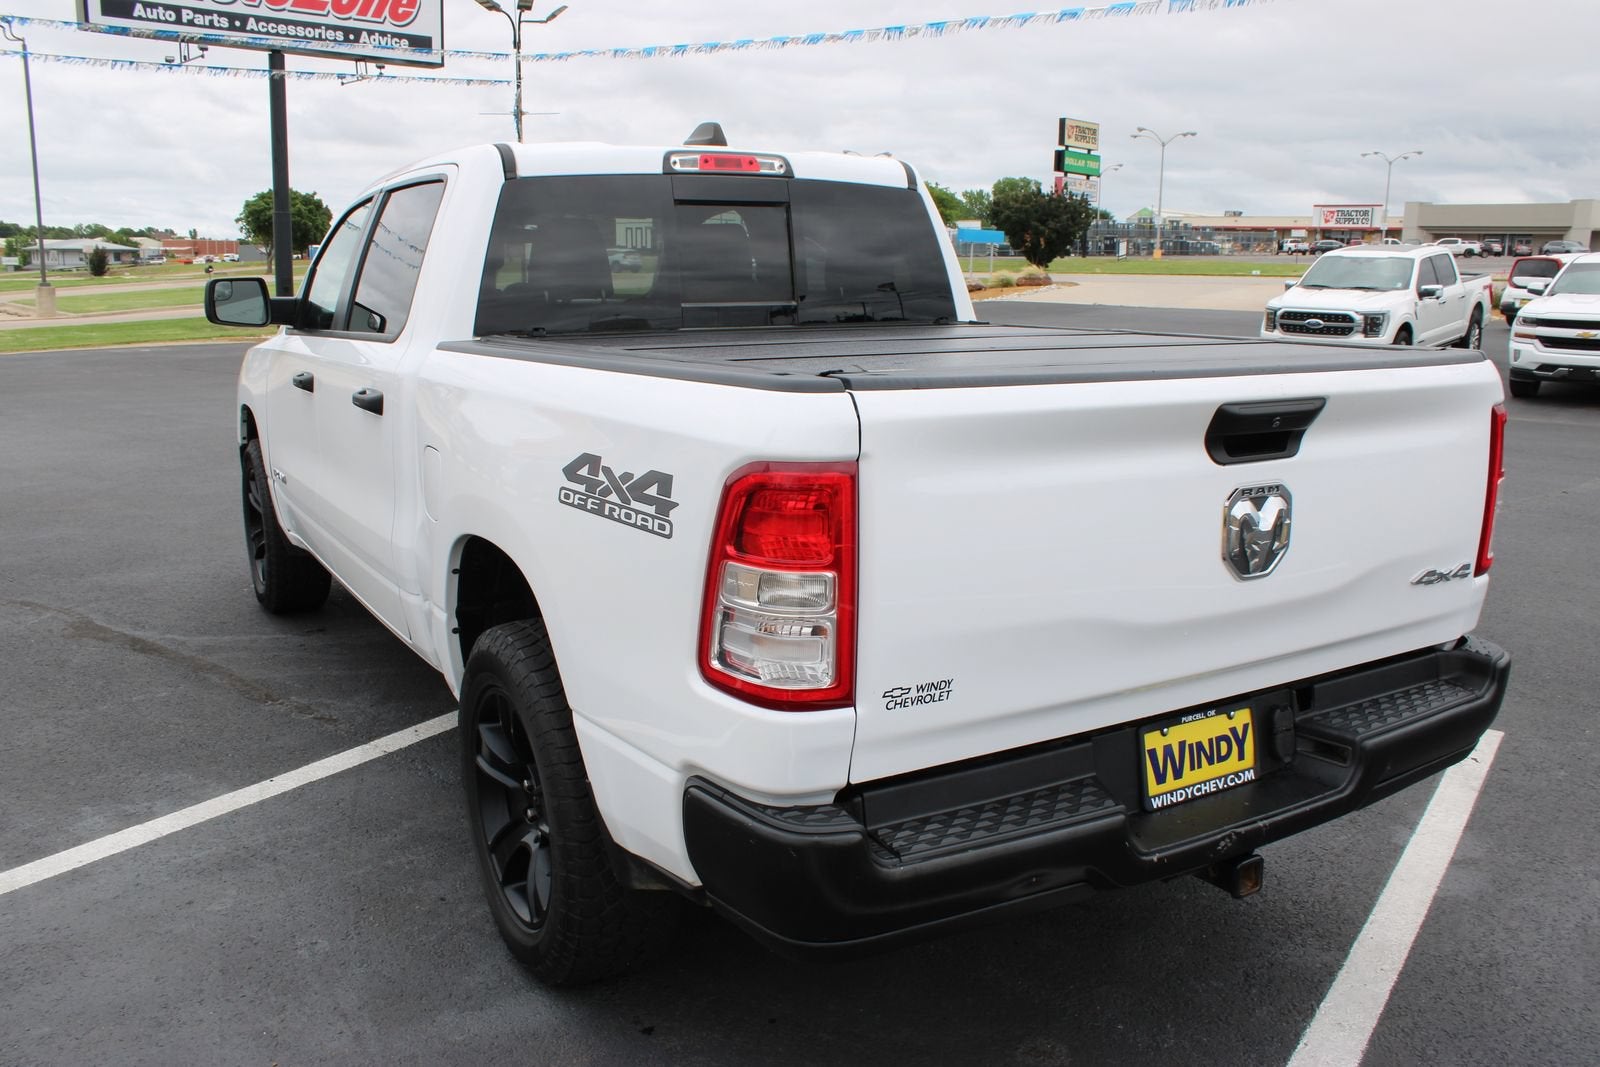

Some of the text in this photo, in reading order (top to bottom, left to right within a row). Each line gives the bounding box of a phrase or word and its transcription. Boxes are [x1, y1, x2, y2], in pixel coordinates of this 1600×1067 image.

[133, 3, 176, 22] Auto
[181, 8, 230, 28] Parts
[246, 17, 344, 41] Accessories
[359, 31, 410, 48] Advice
[1074, 125, 1097, 136] TRACTOR
[1335, 217, 1361, 225] SUPPLY
[1336, 209, 1370, 217] TRACTOR
[1241, 486, 1280, 496] RAM
[560, 489, 671, 535] OFF ROAD
[916, 678, 954, 694] WINDY
[885, 690, 952, 710] CHEVROLET
[1147, 722, 1250, 786] WINDY
[1151, 769, 1255, 809] WINDYCHEV.COM
